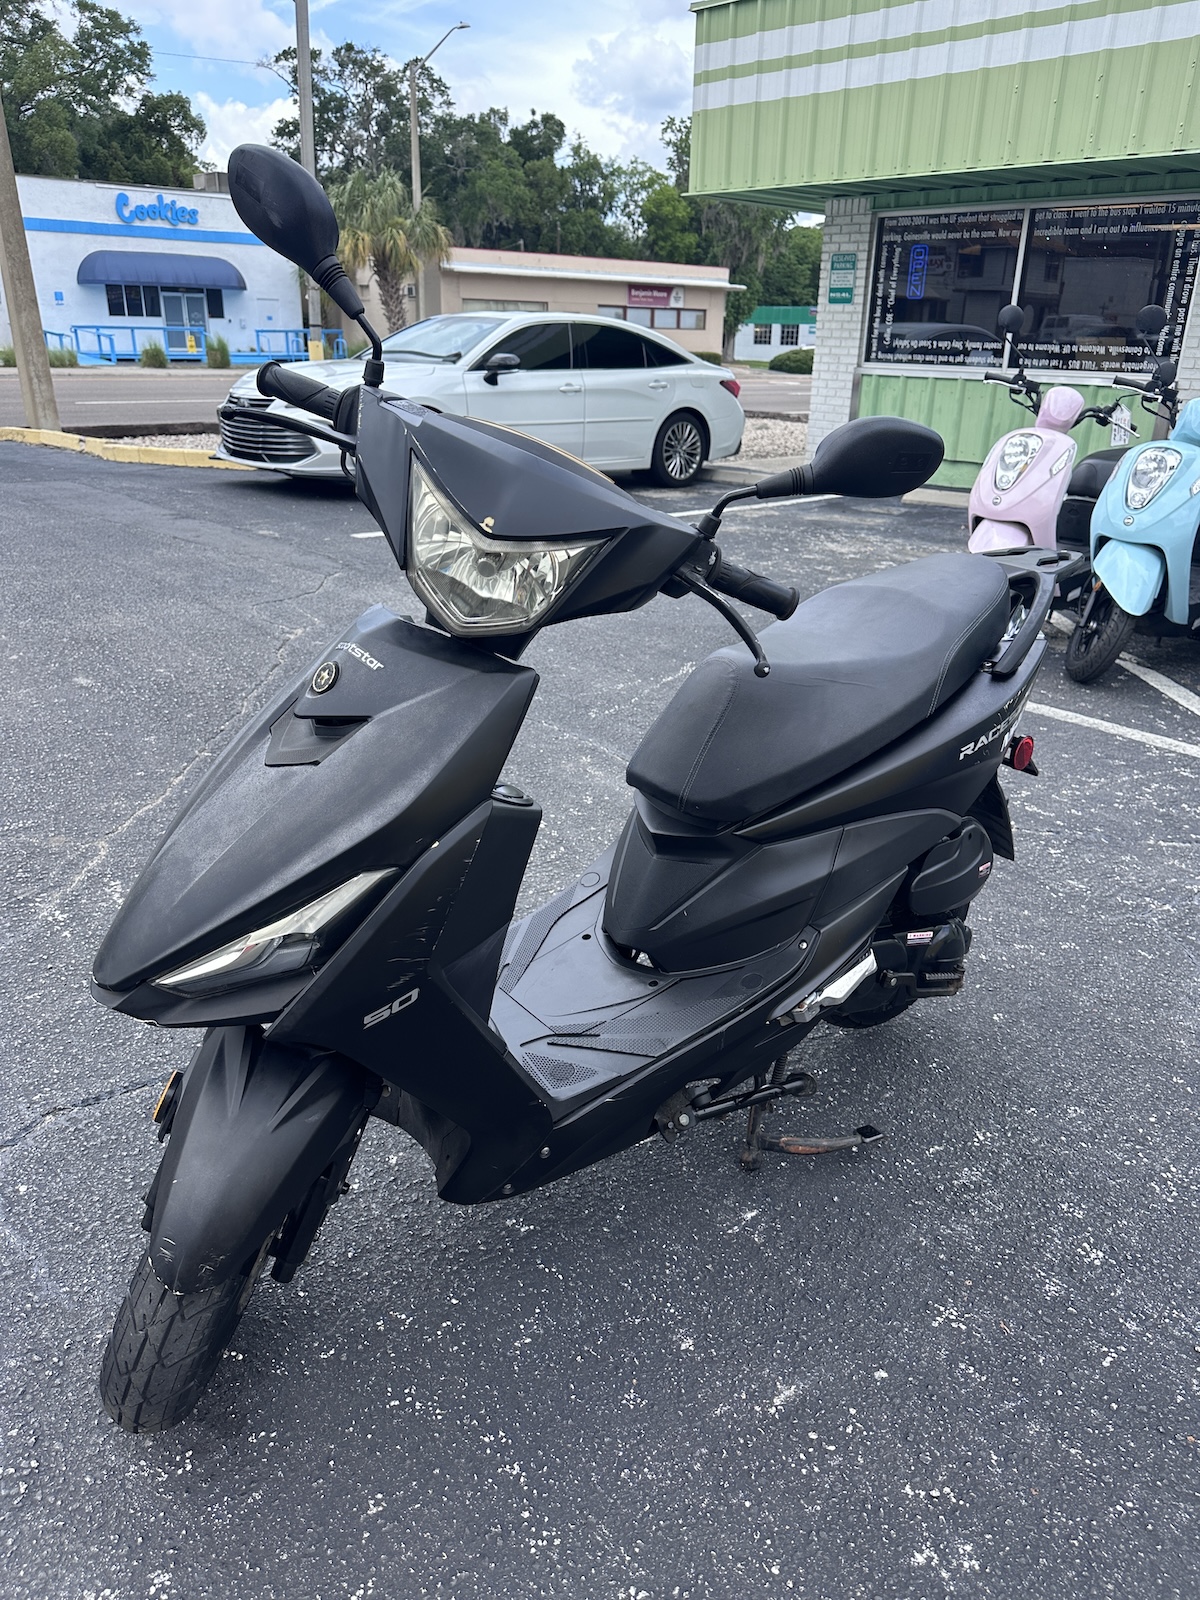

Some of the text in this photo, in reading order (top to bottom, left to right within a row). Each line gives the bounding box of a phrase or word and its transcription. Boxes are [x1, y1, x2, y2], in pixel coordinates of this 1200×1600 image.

[115, 192, 199, 226] Cookies
[884, 218, 897, 226] From
[929, 217, 939, 225] was
[940, 215, 948, 224] the
[958, 213, 977, 224] student
[978, 213, 989, 223] that
[990, 211, 1015, 223] struggled
[1016, 212, 1023, 220] to
[1035, 211, 1045, 222] get
[1046, 211, 1052, 219] to
[1053, 209, 1068, 219] class.
[1074, 208, 1089, 218] went
[1090, 208, 1097, 217] to
[1098, 207, 1109, 217] the
[1110, 206, 1121, 216] bus
[1122, 206, 1137, 218] stop.
[1144, 205, 1166, 214] waited
[1168, 203, 1176, 213] 15
[1177, 202, 1200, 213] minute
[903, 230, 931, 241] Gainesville
[931, 229, 948, 240] would
[948, 231, 962, 240] never
[963, 229, 970, 239] be
[971, 229, 980, 238] the
[981, 231, 996, 239] same.
[998, 228, 1011, 237] Now
[1011, 229, 1021, 239] my
[1034, 223, 1062, 237] incredible
[1063, 226, 1079, 235] team
[1080, 223, 1092, 234] and
[1098, 226, 1108, 234] are
[1110, 224, 1120, 233] out
[1121, 224, 1128, 233] to
[1174, 247, 1182, 258] an
[1170, 259, 1181, 281] entire
[1185, 257, 1198, 275] Then
[878, 268, 886, 283] with
[909, 248, 926, 297] OPEN
[876, 283, 884, 298] deal
[889, 281, 897, 289] of
[631, 288, 652, 298] Benjamin
[653, 290, 667, 298] Moore
[1180, 283, 1193, 304] drove
[873, 305, 882, 318] bus
[1177, 307, 1186, 324] past
[872, 318, 880, 330] the
[871, 330, 879, 339] for
[1174, 324, 1183, 336] me
[911, 340, 918, 349] On
[918, 340, 932, 349] Scoot
[938, 340, 951, 350] Calm
[952, 339, 963, 350] Stay
[964, 340, 982, 351] family.
[1155, 324, 1170, 356] Welcome
[1171, 336, 1182, 353] with
[983, 342, 1002, 350] scooter
[1017, 342, 1027, 351] our
[1028, 343, 1034, 352] to
[1035, 343, 1060, 354] Welcome
[1072, 345, 1078, 354] to
[1079, 345, 1105, 356] Welcome
[1108, 345, 1143, 356] Gainesville.
[877, 351, 893, 362] having
[894, 353, 912, 363] without
[913, 353, 924, 363] class
[925, 354, 937, 364] from
[938, 355, 948, 364] and
[949, 355, 955, 364] to
[955, 355, 964, 365] get
[965, 354, 986, 365] students
[986, 354, 1003, 366] ollege
[1032, 358, 1038, 367] to
[1039, 358, 1049, 367] out
[1050, 359, 1059, 368] set
[1121, 361, 1159, 373] forgettable
[363, 988, 420, 1030] 50
